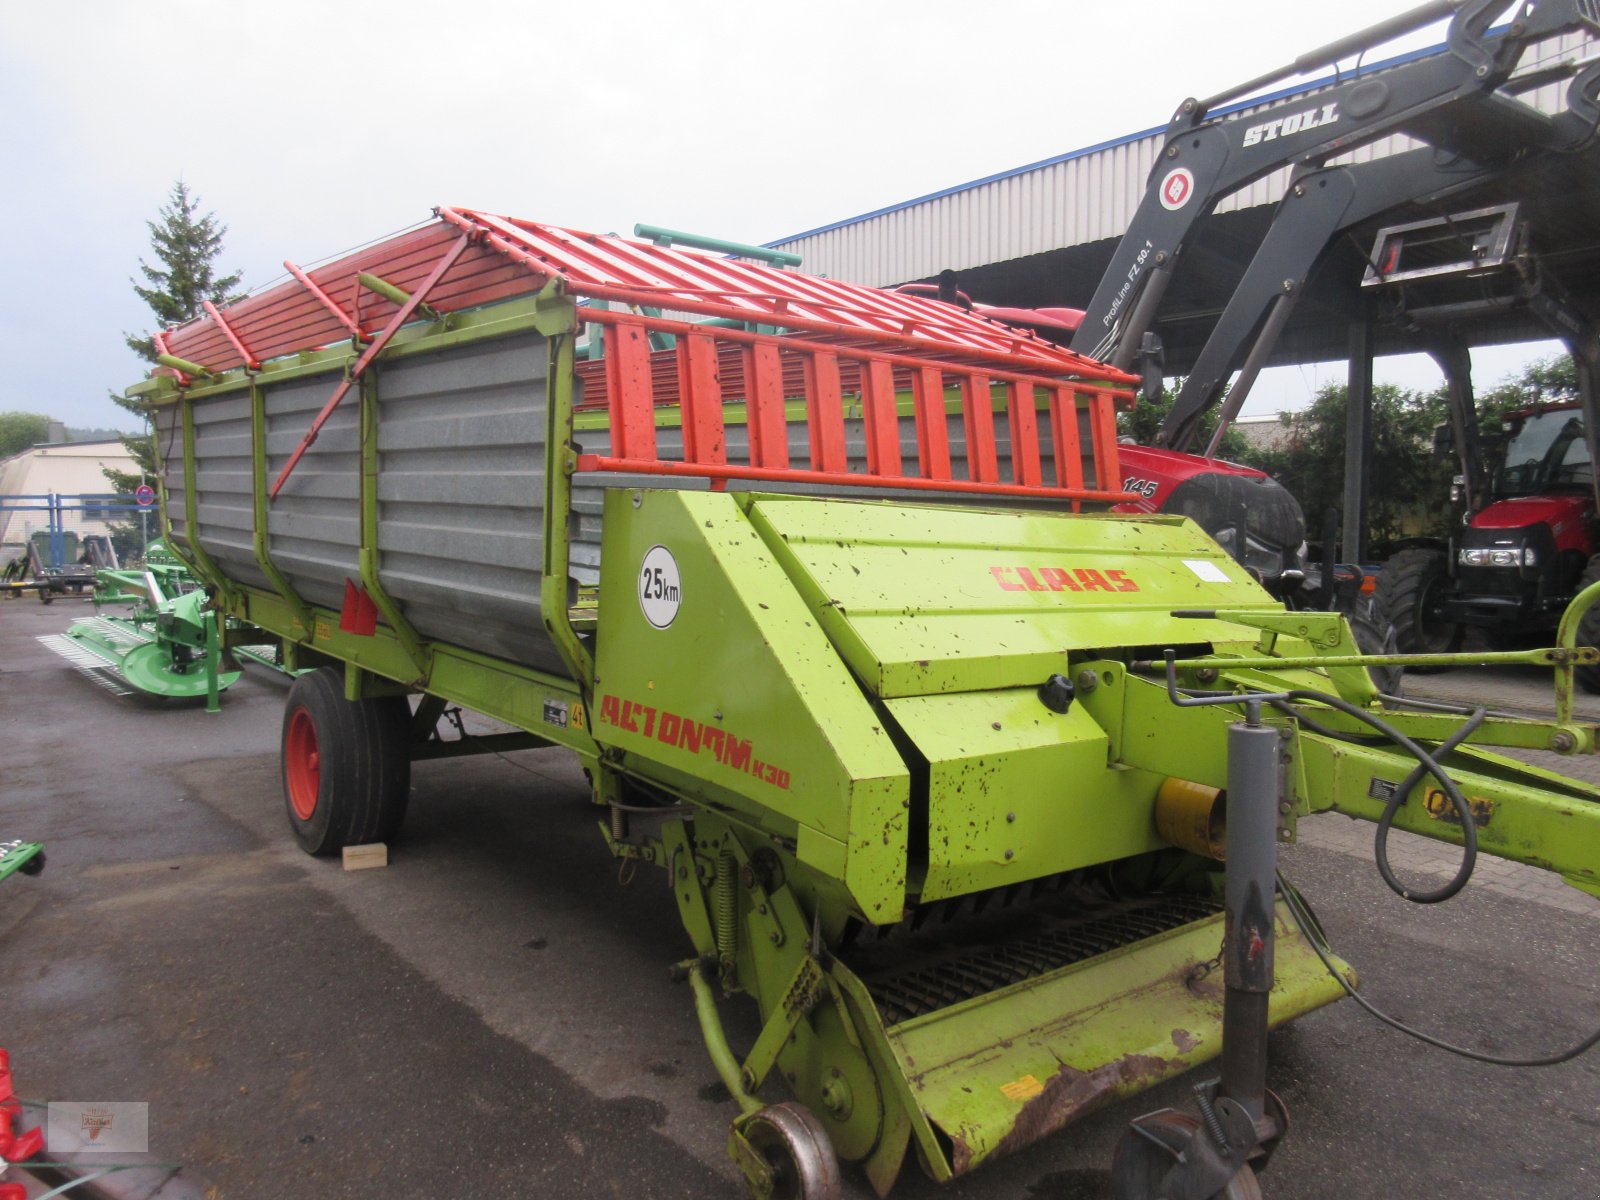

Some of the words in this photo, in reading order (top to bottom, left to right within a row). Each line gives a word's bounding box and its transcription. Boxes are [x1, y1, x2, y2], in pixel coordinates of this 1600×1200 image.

[1243, 103, 1339, 147] STOLL
[1103, 282, 1130, 326] ProfiLine
[1128, 264, 1140, 281] FZ
[1137, 240, 1152, 265] 50.1
[1122, 476, 1158, 498] 145
[990, 566, 1140, 592] CLAAS
[752, 759, 790, 790] K30
